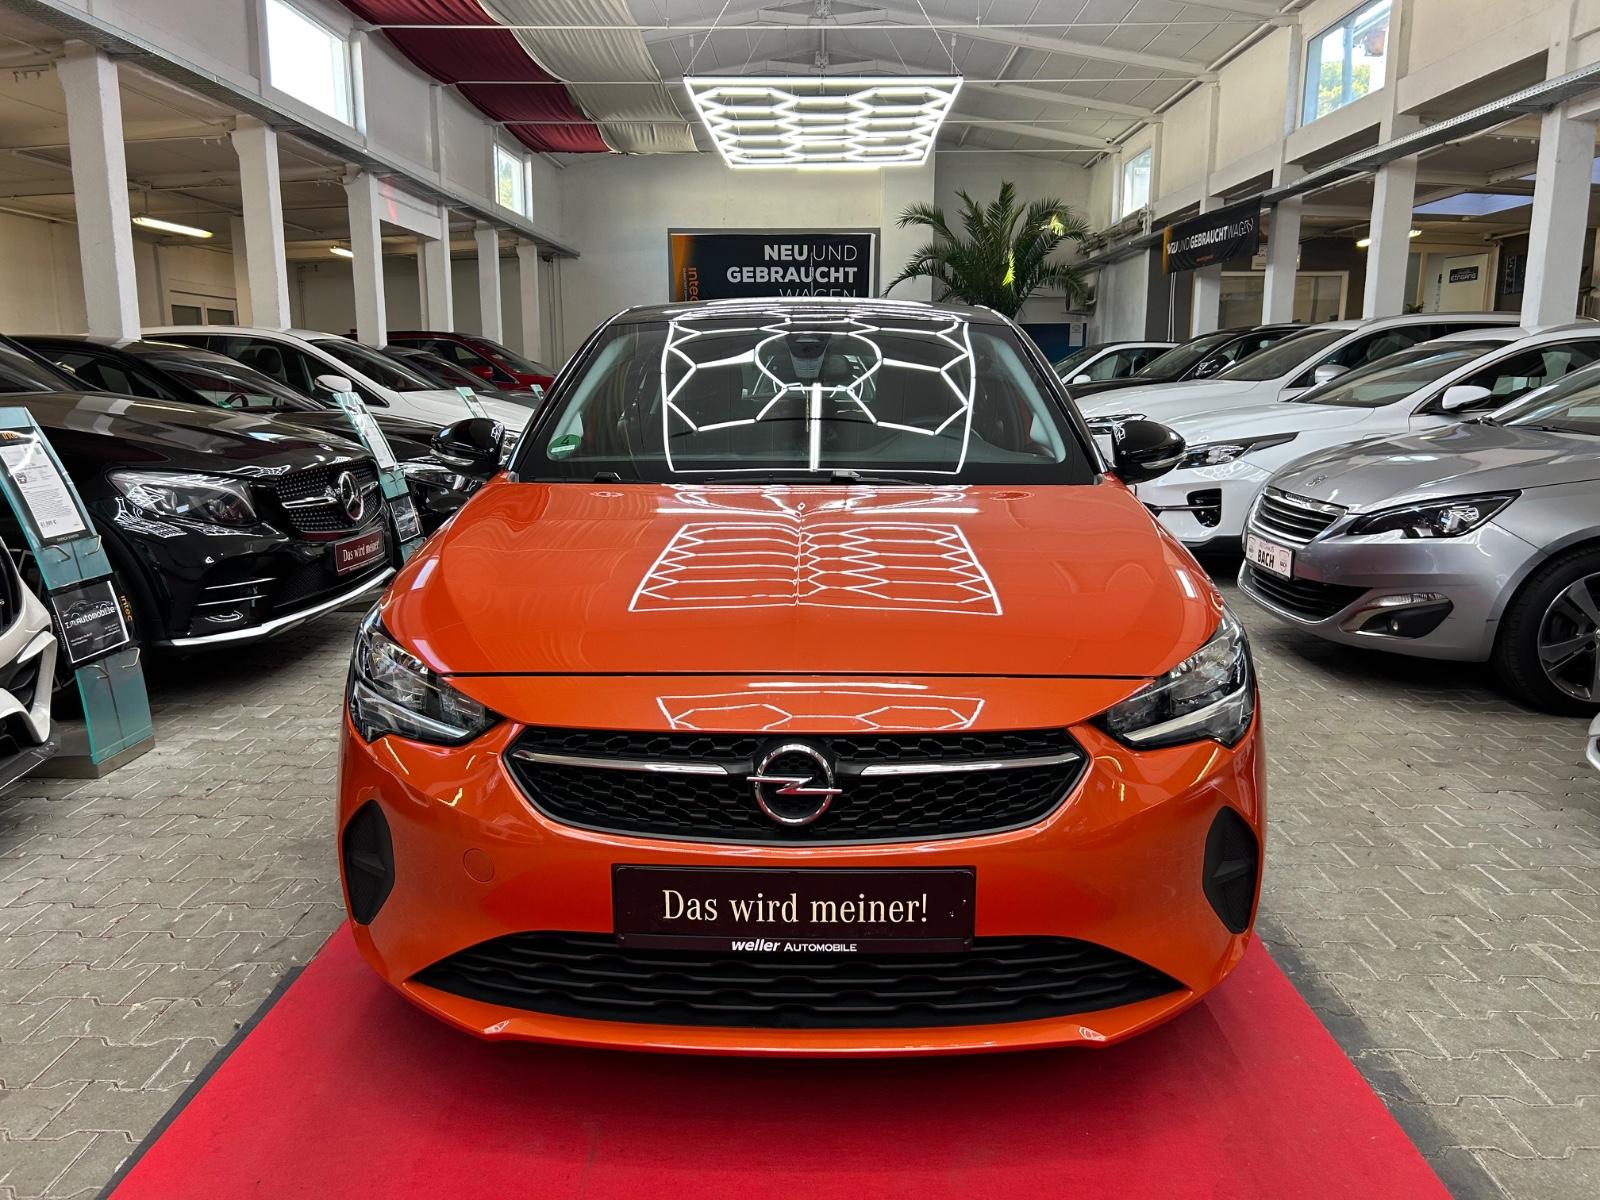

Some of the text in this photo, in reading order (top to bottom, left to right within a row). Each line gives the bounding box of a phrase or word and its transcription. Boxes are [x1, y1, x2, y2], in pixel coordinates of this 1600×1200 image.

[726, 266, 858, 284] GEBRAUCHT
[342, 549, 353, 562] Das
[354, 544, 365, 557] wird
[1257, 549, 1275, 569] BACH
[662, 889, 927, 923] Das wird meiner!
[731, 938, 857, 952] weller AUTOMOBILE
